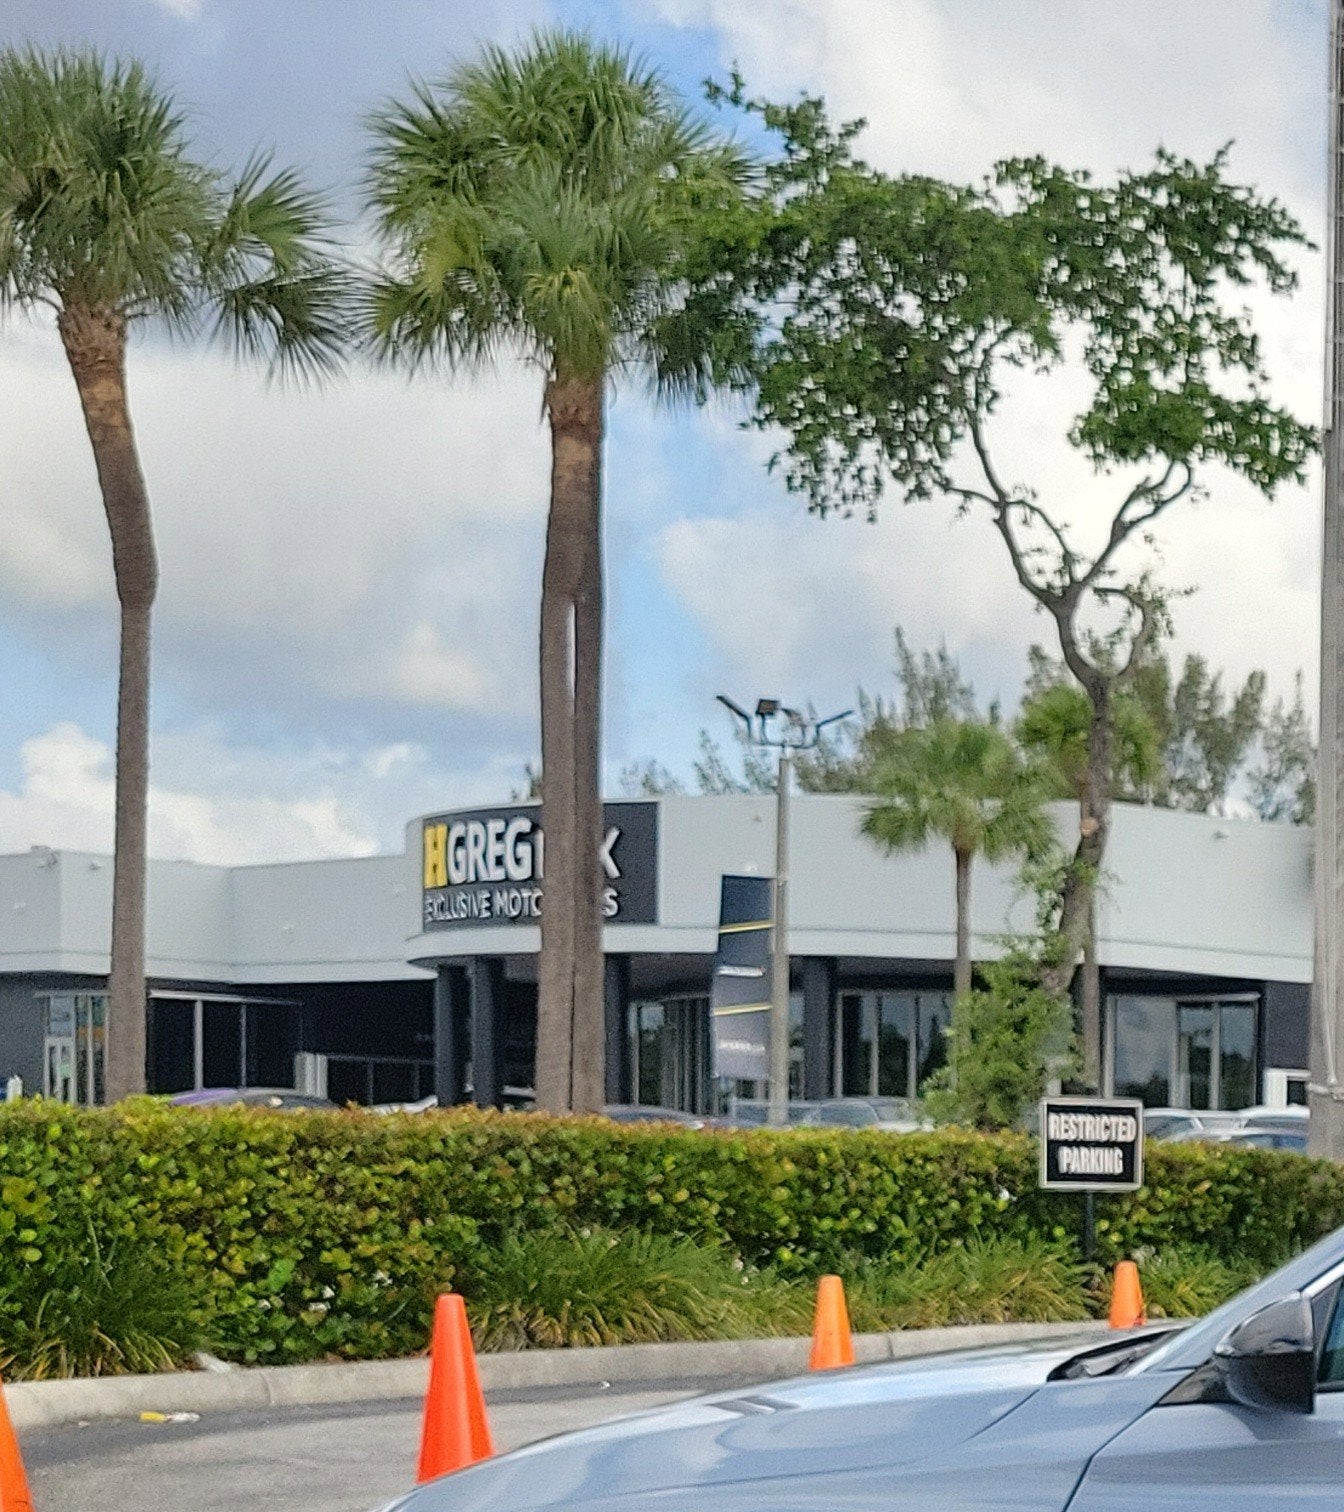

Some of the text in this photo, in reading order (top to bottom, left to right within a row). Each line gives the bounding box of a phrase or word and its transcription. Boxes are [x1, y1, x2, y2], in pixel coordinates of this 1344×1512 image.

[424, 890, 492, 923] EXCLUSIVE
[1048, 1112, 1137, 1142] RESTRICTED
[1058, 1146, 1124, 1175] PARKING
